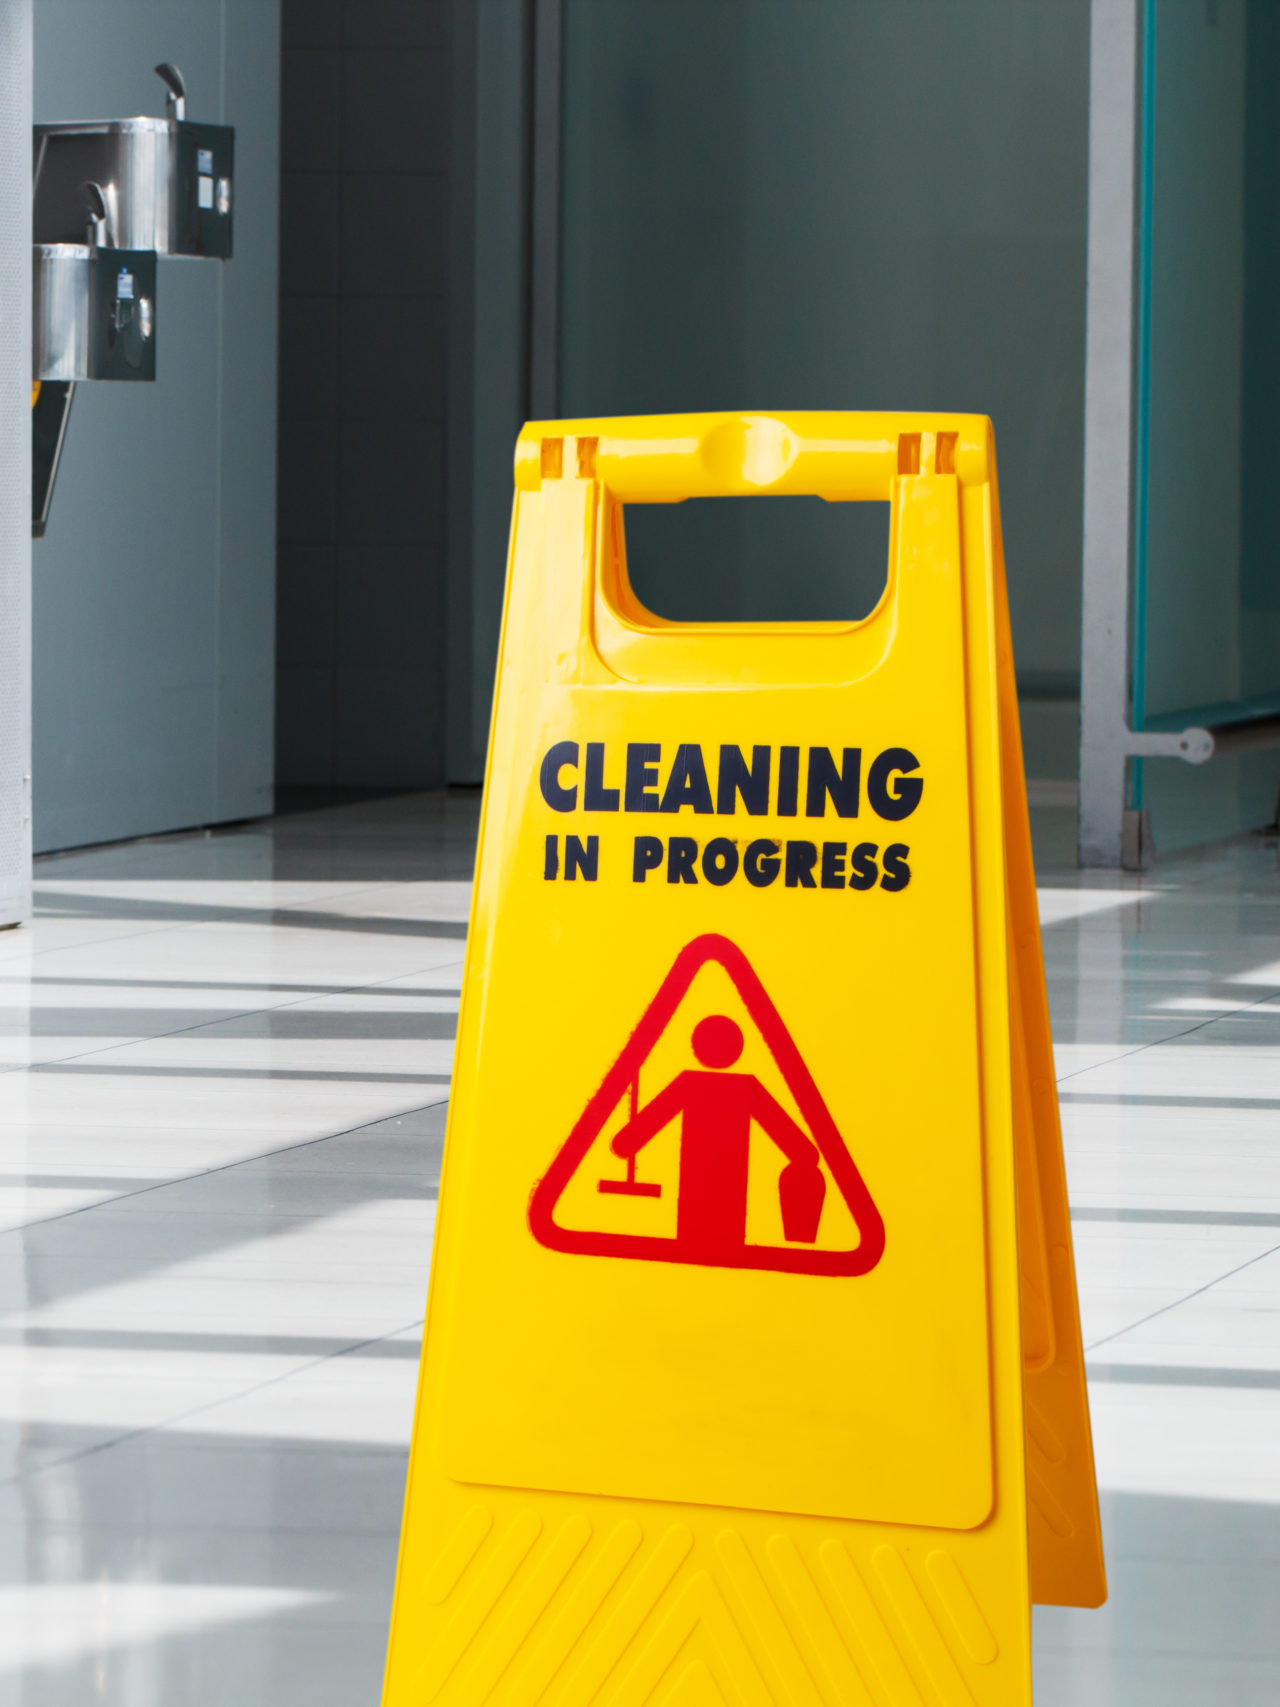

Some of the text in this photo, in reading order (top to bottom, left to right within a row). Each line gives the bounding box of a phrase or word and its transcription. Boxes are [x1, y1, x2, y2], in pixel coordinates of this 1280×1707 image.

[539, 741, 924, 822] CLEANING
[543, 834, 912, 892] IN PROGRESS
